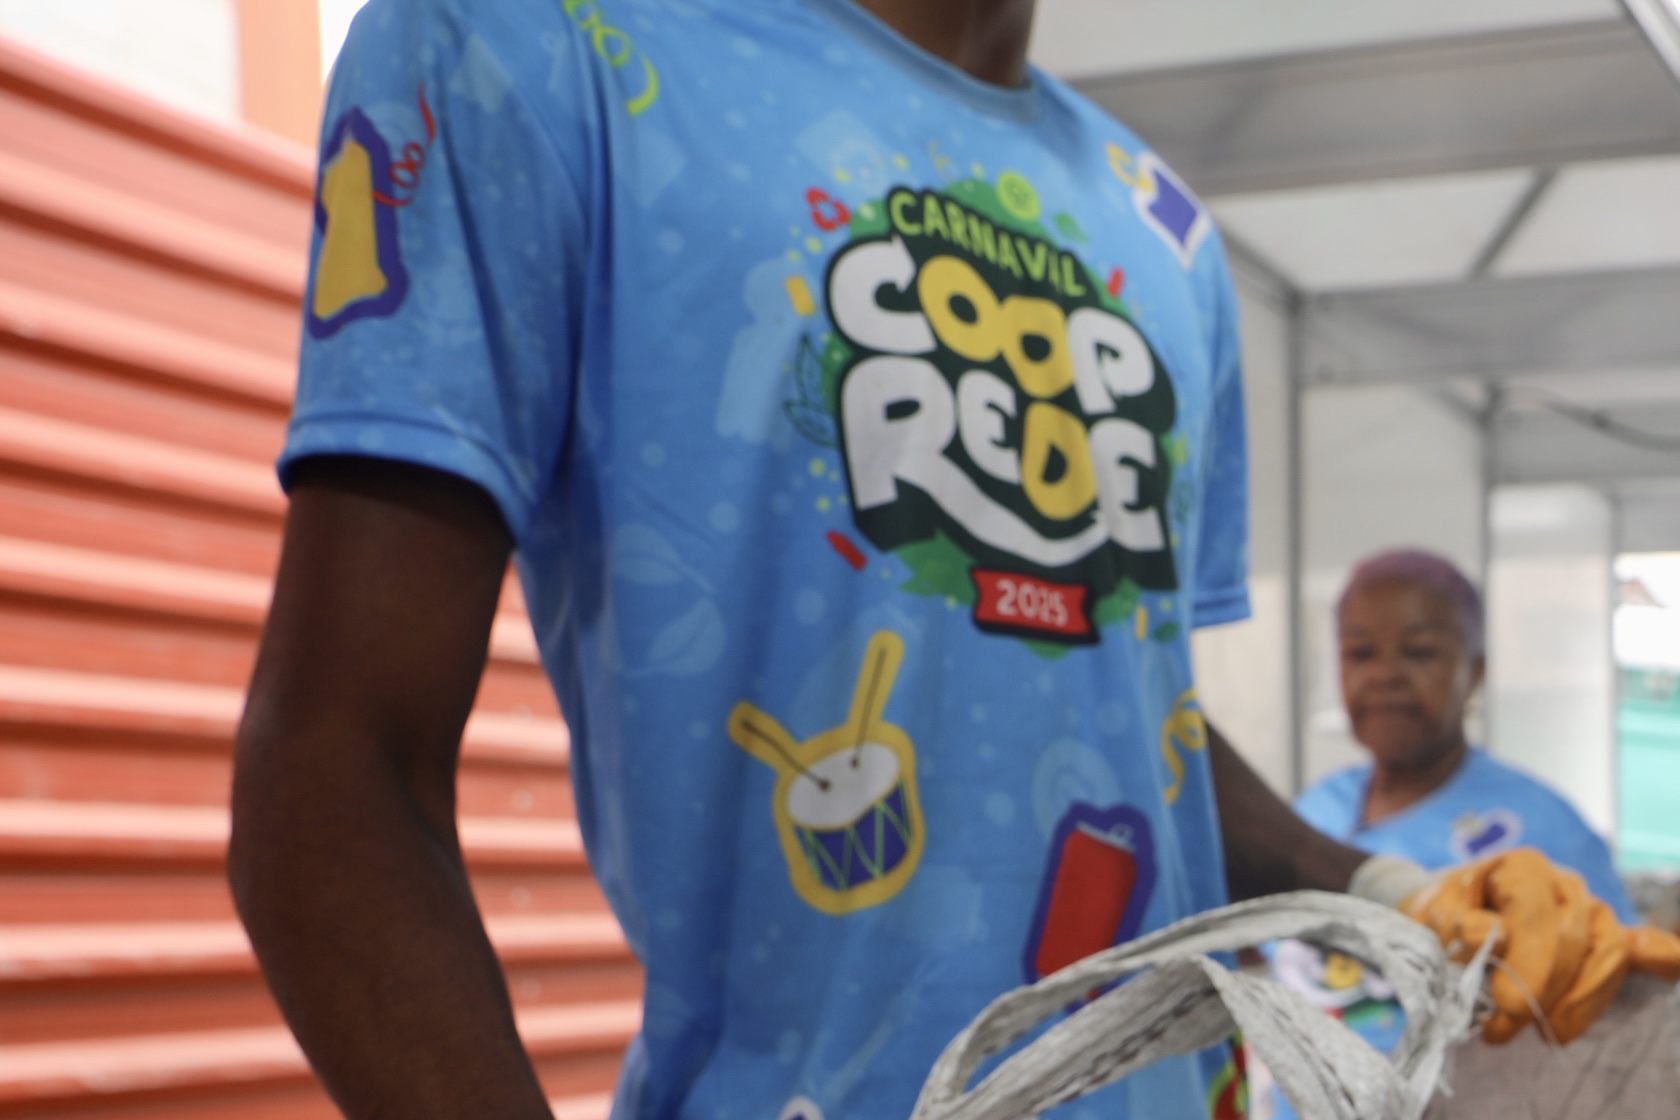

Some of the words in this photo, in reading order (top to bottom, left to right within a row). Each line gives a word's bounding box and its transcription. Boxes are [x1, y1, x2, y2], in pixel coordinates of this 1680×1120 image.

[890, 192, 1087, 297] CARNAVIL
[830, 235, 1156, 414] COOP
[841, 355, 1166, 568] REDE
[996, 580, 1070, 627] 2025
